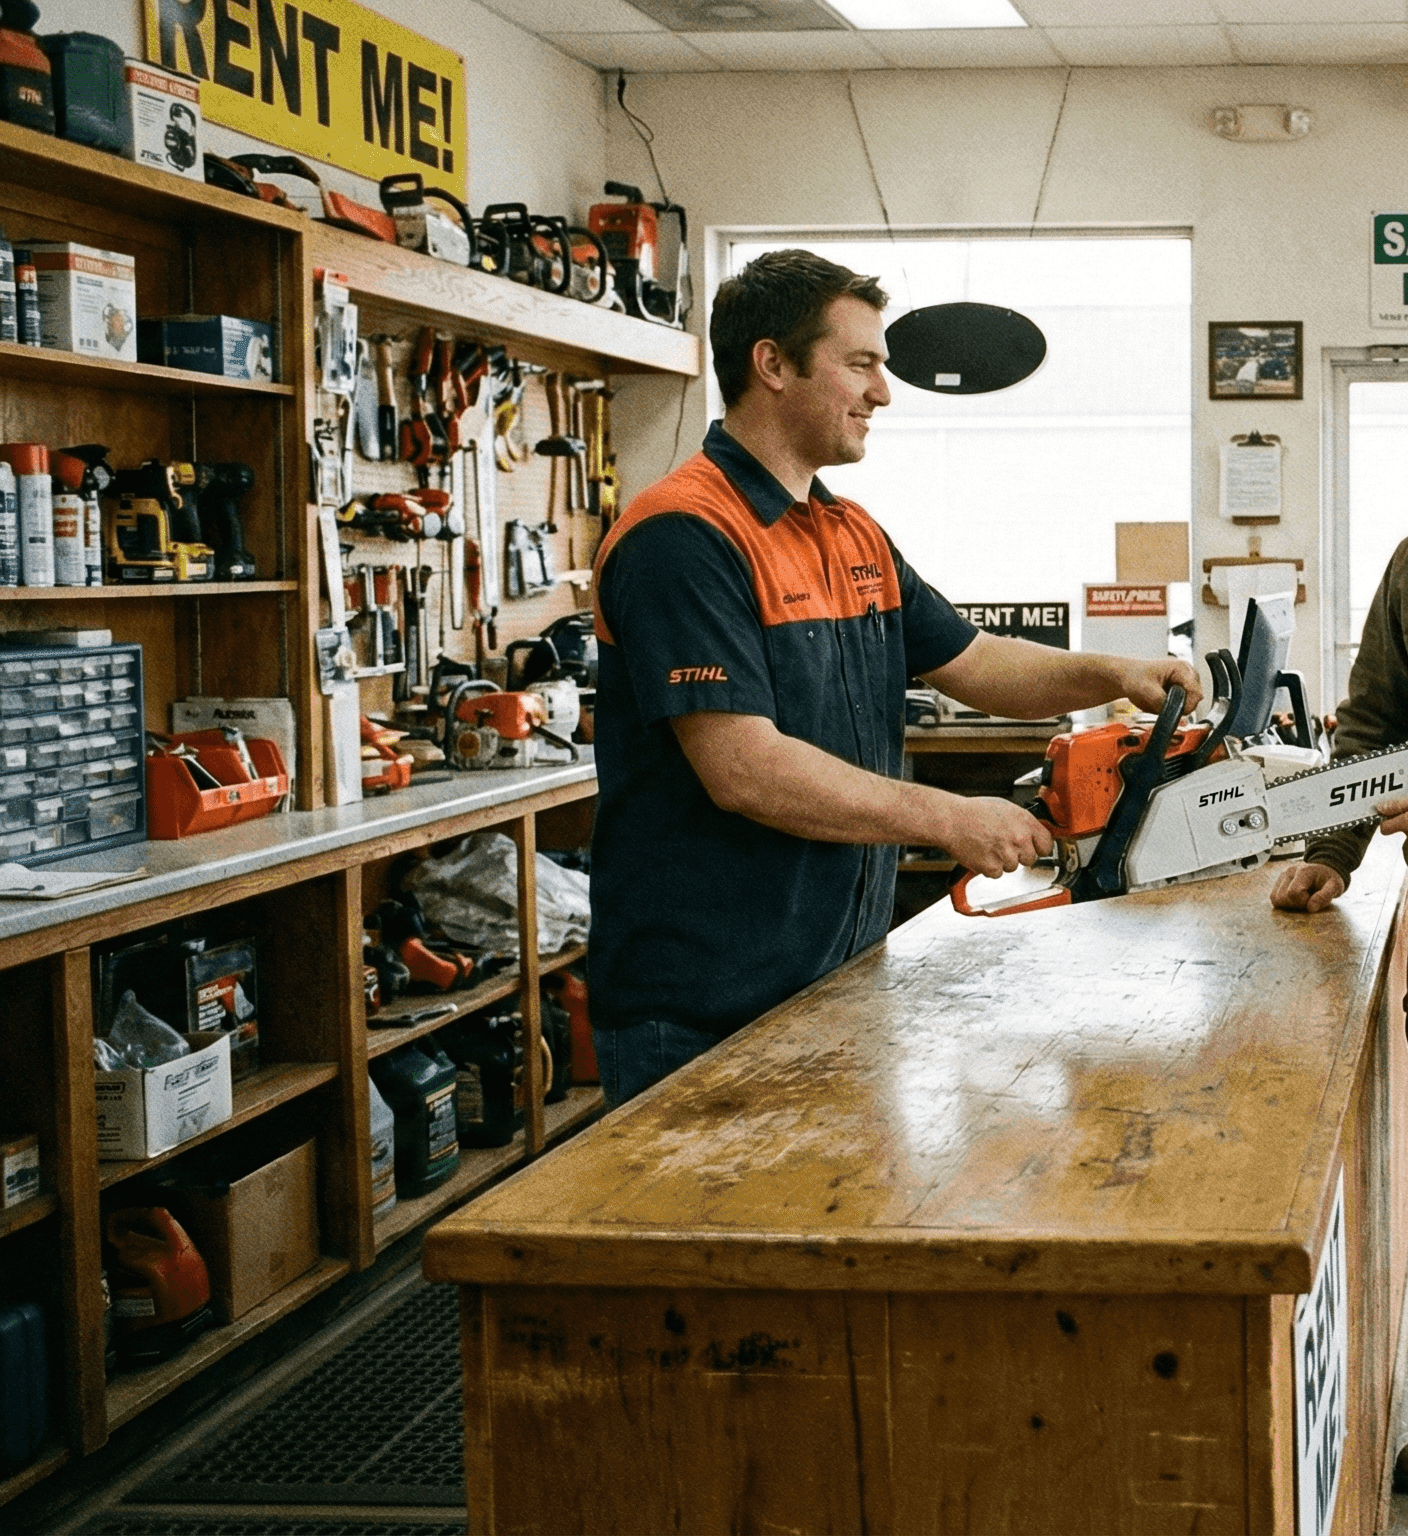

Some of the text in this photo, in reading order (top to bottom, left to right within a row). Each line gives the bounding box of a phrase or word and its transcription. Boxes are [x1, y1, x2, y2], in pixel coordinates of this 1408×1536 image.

[159, 0, 453, 174] RENT ME!
[1022, 607, 1064, 626] ME!
[669, 666, 728, 683] STIHL
[1198, 786, 1244, 808] STIHL
[1329, 772, 1403, 807] STIHL
[1304, 1200, 1340, 1458] RENT
